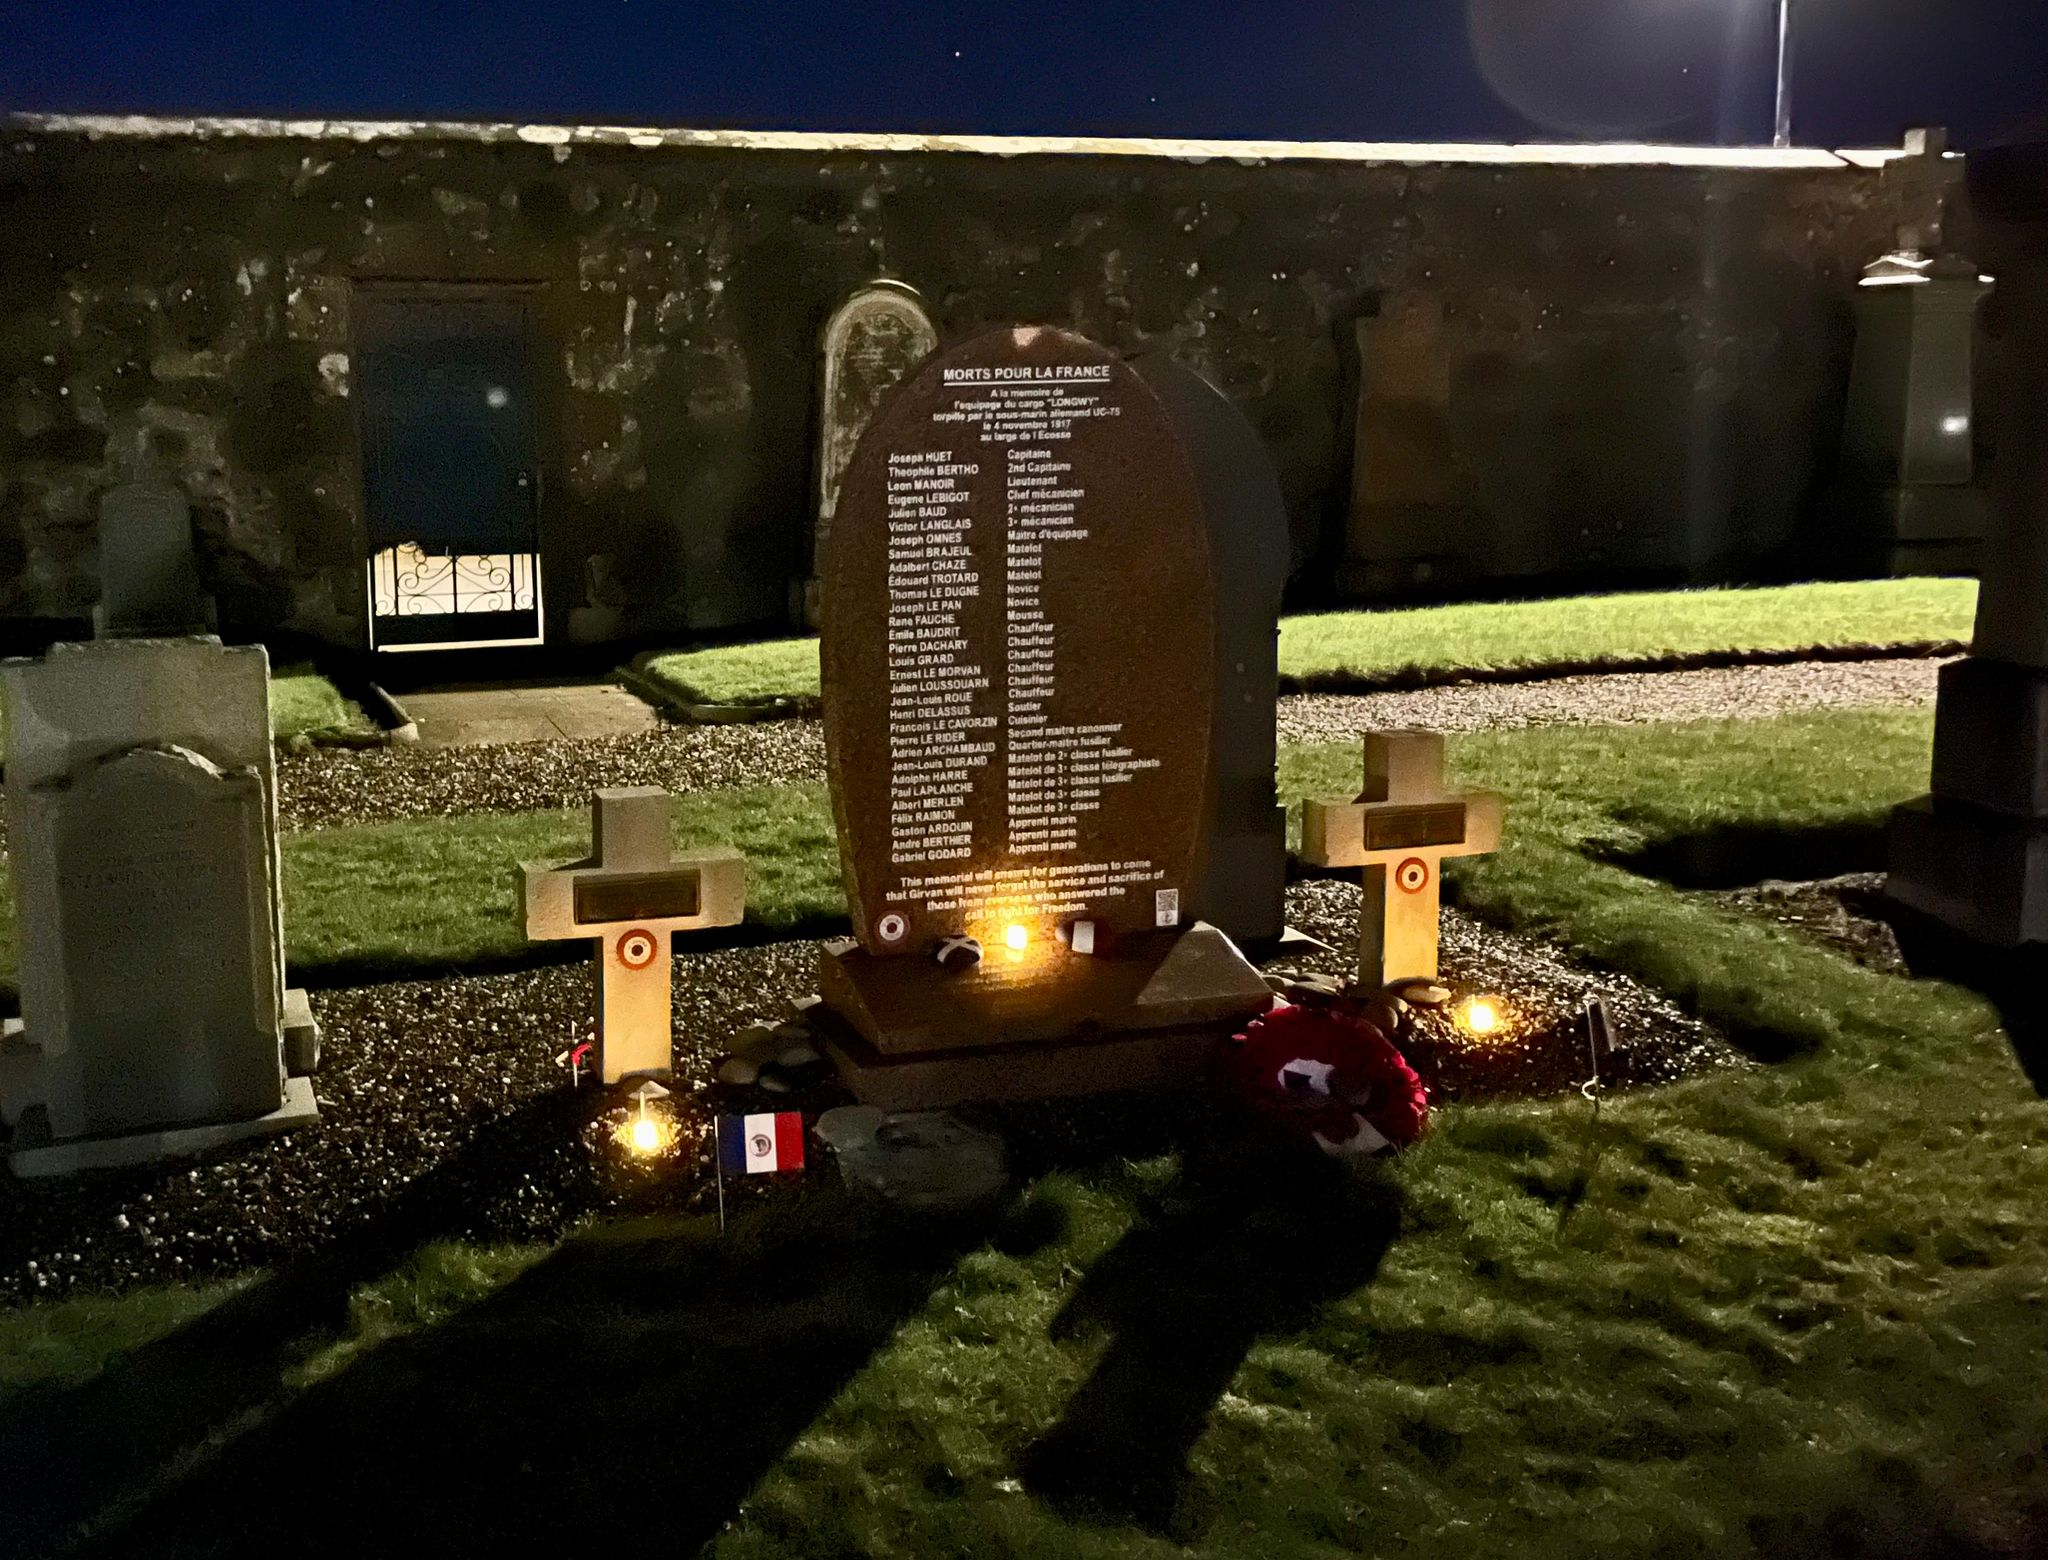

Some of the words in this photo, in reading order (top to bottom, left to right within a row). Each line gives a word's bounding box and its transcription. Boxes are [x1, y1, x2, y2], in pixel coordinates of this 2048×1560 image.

[943, 368, 991, 381] MORTS
[994, 367, 1032, 380] POUR
[1035, 367, 1054, 379] LA
[1056, 365, 1110, 378] FRANCE
[999, 389, 1009, 398] la
[1052, 387, 1064, 396] de
[1004, 400, 1016, 408] du
[1018, 400, 1045, 408] cargo
[967, 412, 983, 422] par
[985, 411, 993, 420] le
[996, 410, 1048, 419] sous-marin
[1049, 408, 1091, 418] allemand
[983, 422, 992, 431] le
[994, 421, 1000, 430] 4
[1002, 421, 1048, 430] novembre
[1050, 419, 1072, 429] 1917
[994, 432, 1017, 443] large
[1019, 432, 1031, 440] de
[888, 453, 924, 464] Joseph
[925, 451, 952, 462] HUET
[1007, 449, 1052, 460] Capitaine
[937, 464, 979, 475] BERTHO
[1007, 463, 1026, 473] 2nd
[1027, 462, 1071, 473] Capitaine
[914, 479, 955, 490] MANOIR
[1007, 476, 1058, 486] Lieutenant
[926, 492, 970, 503] LEBIGOT
[1007, 489, 1029, 500] Chef
[918, 506, 947, 517] BAUD
[888, 522, 918, 532] Victor
[920, 519, 972, 530] LANGLAIS
[888, 535, 924, 546] Joseph
[888, 549, 924, 559] Samuel
[925, 546, 972, 557] BRAJEUL
[1007, 544, 1042, 554] Matelot
[889, 562, 930, 573] Adalbert
[932, 560, 967, 571] CHAZE
[1007, 557, 1042, 567] Matelot
[931, 573, 979, 584] TROTARD
[1007, 570, 1042, 580] Matelot
[889, 589, 928, 600] Thomas
[929, 587, 942, 598] LE
[945, 586, 980, 597] DUGNE
[1007, 584, 1040, 594] Novice
[889, 603, 924, 614] Joseph
[926, 601, 939, 612] LE
[941, 600, 962, 610] PAN
[1007, 597, 1040, 607] Novice
[915, 614, 955, 625] FAUCHE
[1007, 610, 1044, 620] Mousse
[1007, 623, 1054, 633] Chauffeur
[889, 643, 917, 654] Pierre
[919, 640, 968, 652] DACHARY
[1007, 636, 1055, 647] Chauffeur
[889, 657, 915, 667] Louis
[917, 654, 954, 665] GRARD
[1007, 649, 1054, 660] Chauffeur
[889, 669, 922, 680] Ernest
[923, 668, 936, 678] LE
[938, 665, 981, 677] MORVAN
[1008, 662, 1054, 673] Chauffeur
[920, 678, 989, 692] LOUSSOUARN
[1008, 674, 1055, 686] Chauffeur
[1008, 687, 1055, 698] Chauffeur
[890, 695, 942, 707] Jean-Louis
[1008, 702, 1042, 712] Soutier
[917, 705, 971, 718] DELASSUS
[933, 720, 946, 730] LE
[947, 717, 998, 730] CAVORZIN
[1008, 714, 1048, 725] Cuisinier
[890, 736, 919, 746] Pierre
[920, 734, 933, 744] LE
[935, 732, 966, 743] RIDER
[1007, 727, 1044, 739] Second
[891, 748, 923, 758] Adrien
[924, 742, 996, 756] ARCHAMBAUD
[1008, 752, 1043, 763] Matelot
[1044, 752, 1056, 761] de
[1070, 750, 1100, 760] classe
[891, 759, 943, 771] Jean-Louis
[945, 756, 988, 768] DURAND
[1007, 766, 1042, 776] Matelot
[1044, 765, 1056, 774] de
[1070, 763, 1100, 773] classe
[891, 774, 931, 785] Adolphe
[1008, 779, 1042, 789] Matelot
[1044, 778, 1056, 787] de
[1070, 775, 1100, 785] classe
[891, 787, 911, 798] Paul
[913, 783, 973, 796] LAPLANCHE
[1008, 791, 1043, 802] Matelot
[1044, 790, 1056, 799] de
[1070, 788, 1101, 798] classe
[891, 800, 921, 811] Albert
[923, 796, 964, 808] MERLEN
[1008, 804, 1043, 815] Matelot
[1044, 802, 1056, 812] de
[1070, 801, 1100, 811] classe
[1008, 816, 1049, 829] Apprenti
[1050, 814, 1077, 825] marin
[891, 826, 926, 837] Gaston
[1008, 829, 1049, 842] Apprenti
[1050, 827, 1077, 838] marin
[922, 835, 972, 848] BERTHIER
[1008, 841, 1049, 855] Apprenti
[1050, 840, 1077, 851] marin
[891, 852, 925, 863] Gabriel
[927, 848, 971, 860] GODARD
[900, 877, 922, 887] This
[924, 872, 974, 886] memorial
[975, 870, 993, 881] will
[1032, 866, 1048, 876] for
[1049, 862, 1109, 876] generations
[1111, 861, 1122, 870] to
[1123, 859, 1152, 870] come
[886, 891, 907, 901] that
[909, 888, 944, 899] Girvan
[945, 885, 963, 896] will
[965, 884, 995, 894] never
[1030, 879, 1046, 889] the
[1048, 877, 1086, 888] service
[1087, 874, 1107, 885] and
[1108, 871, 1152, 883] sacrifice
[1153, 869, 1165, 880] of
[927, 900, 957, 911] those
[958, 898, 983, 908] from
[1035, 890, 1057, 901] who
[1058, 886, 1107, 900] answered
[1109, 886, 1126, 896] the
[964, 909, 984, 921] call
